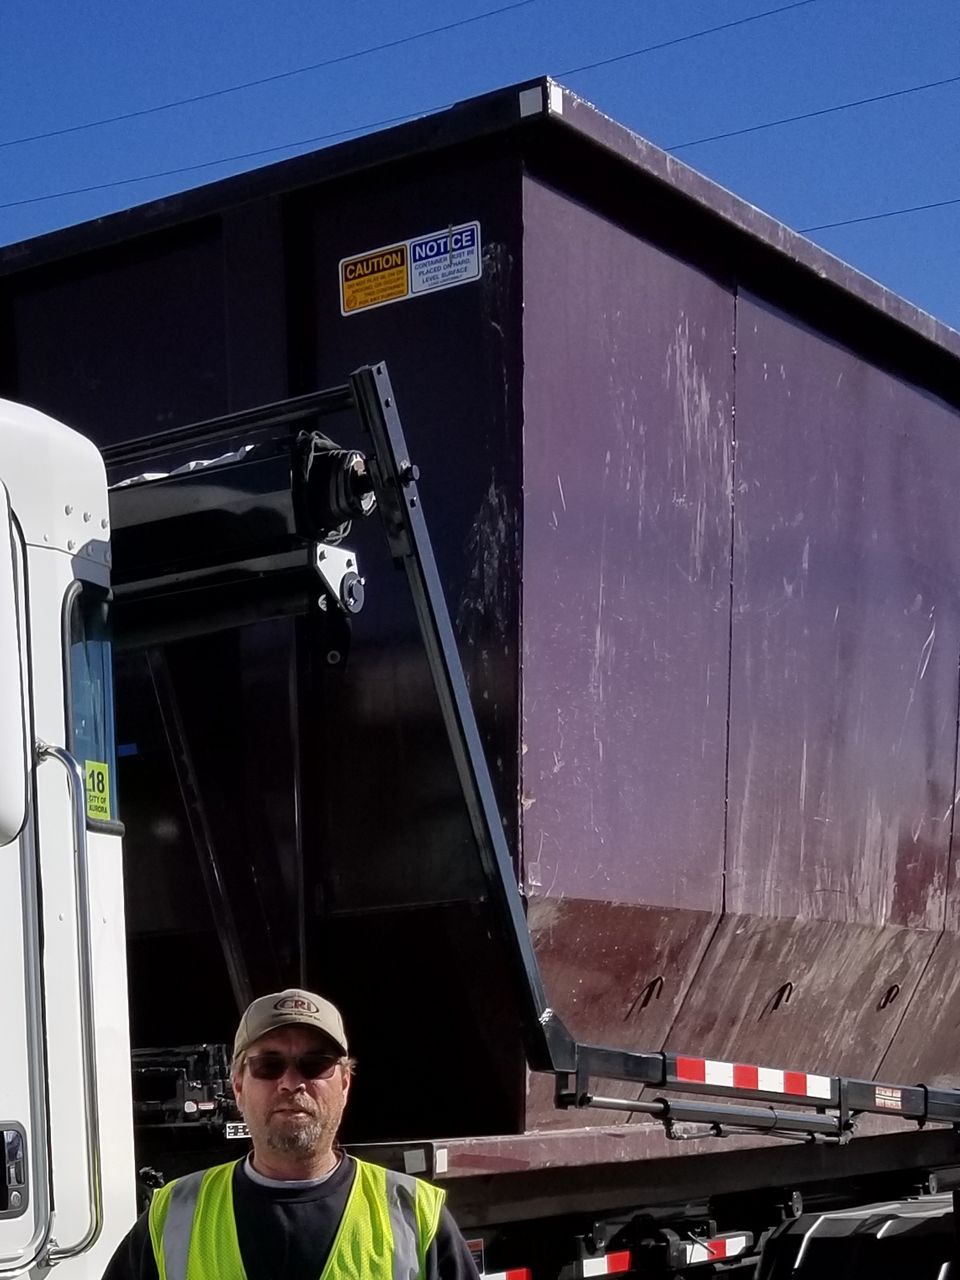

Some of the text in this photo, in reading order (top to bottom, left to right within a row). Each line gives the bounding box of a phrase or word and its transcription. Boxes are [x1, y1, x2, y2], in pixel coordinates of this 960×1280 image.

[415, 231, 472, 260] NOTICE
[346, 251, 401, 279] CAUTION
[89, 769, 105, 793] 18
[281, 1000, 312, 1012] CRI
